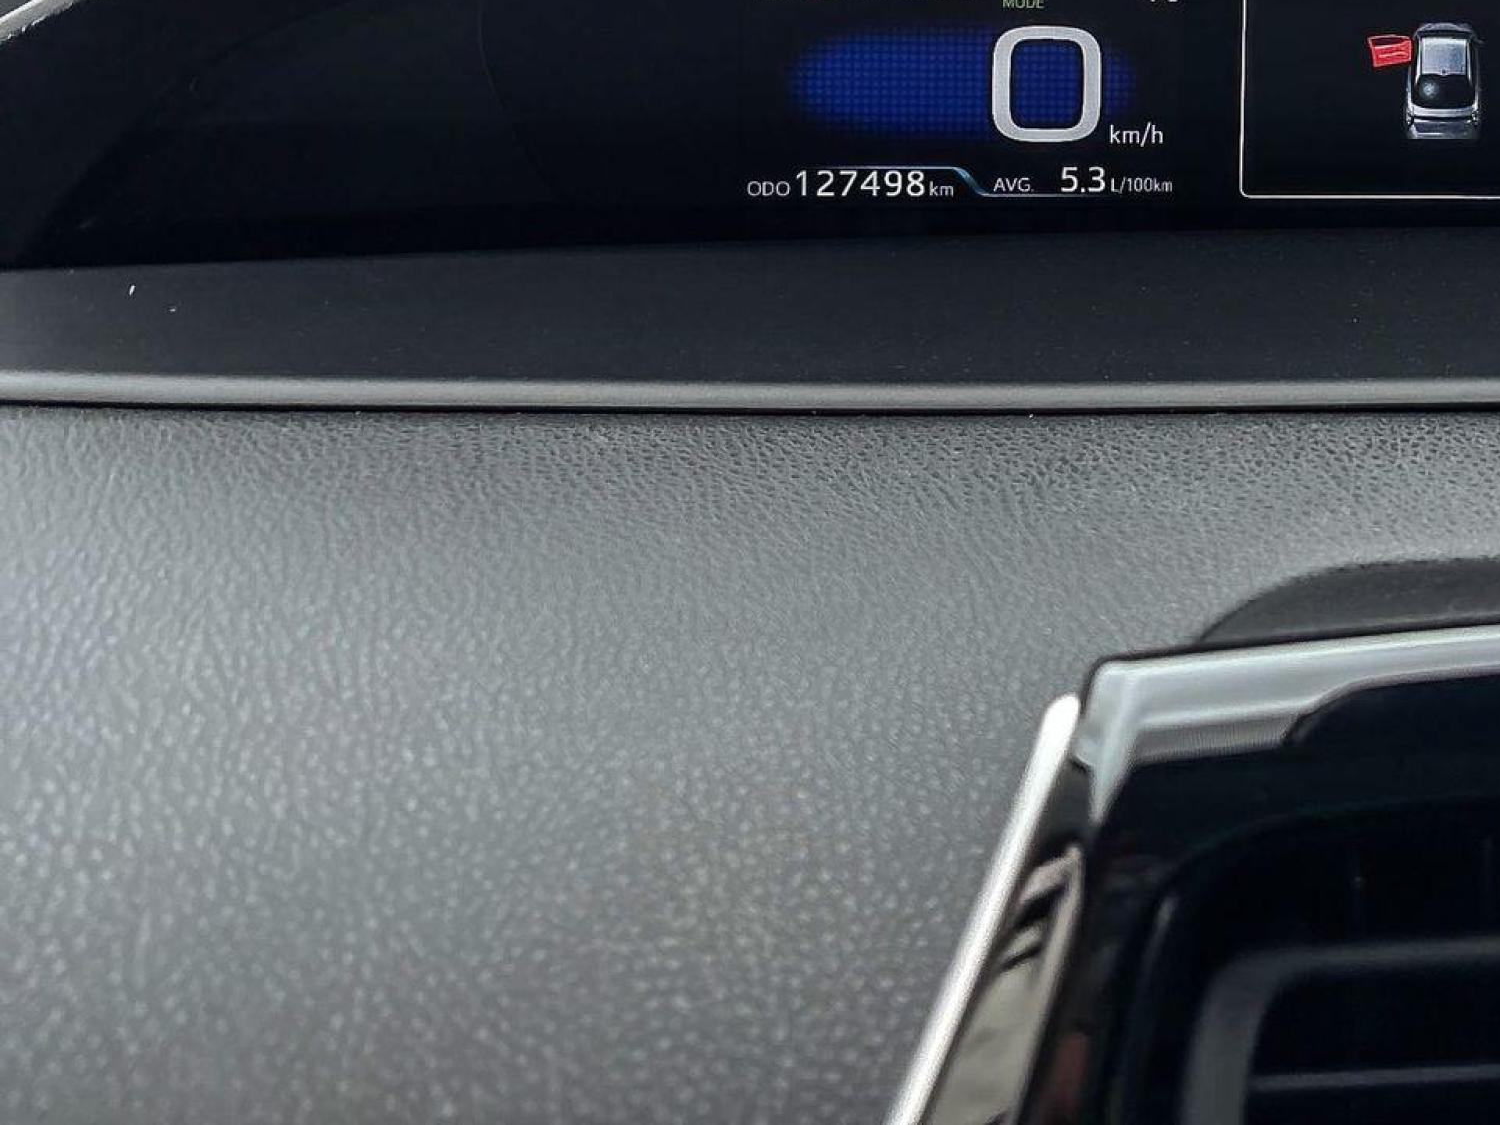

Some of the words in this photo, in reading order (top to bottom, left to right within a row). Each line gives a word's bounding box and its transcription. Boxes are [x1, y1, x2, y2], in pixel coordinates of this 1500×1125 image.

[991, 25, 1101, 143] 0
[1109, 122, 1164, 148] km/h
[746, 180, 791, 198] ODO
[797, 169, 926, 198] 127498
[929, 180, 954, 197] km
[993, 177, 1035, 193] AVG.
[1060, 166, 1106, 193] 5.3
[1110, 177, 1173, 195] L/100km
